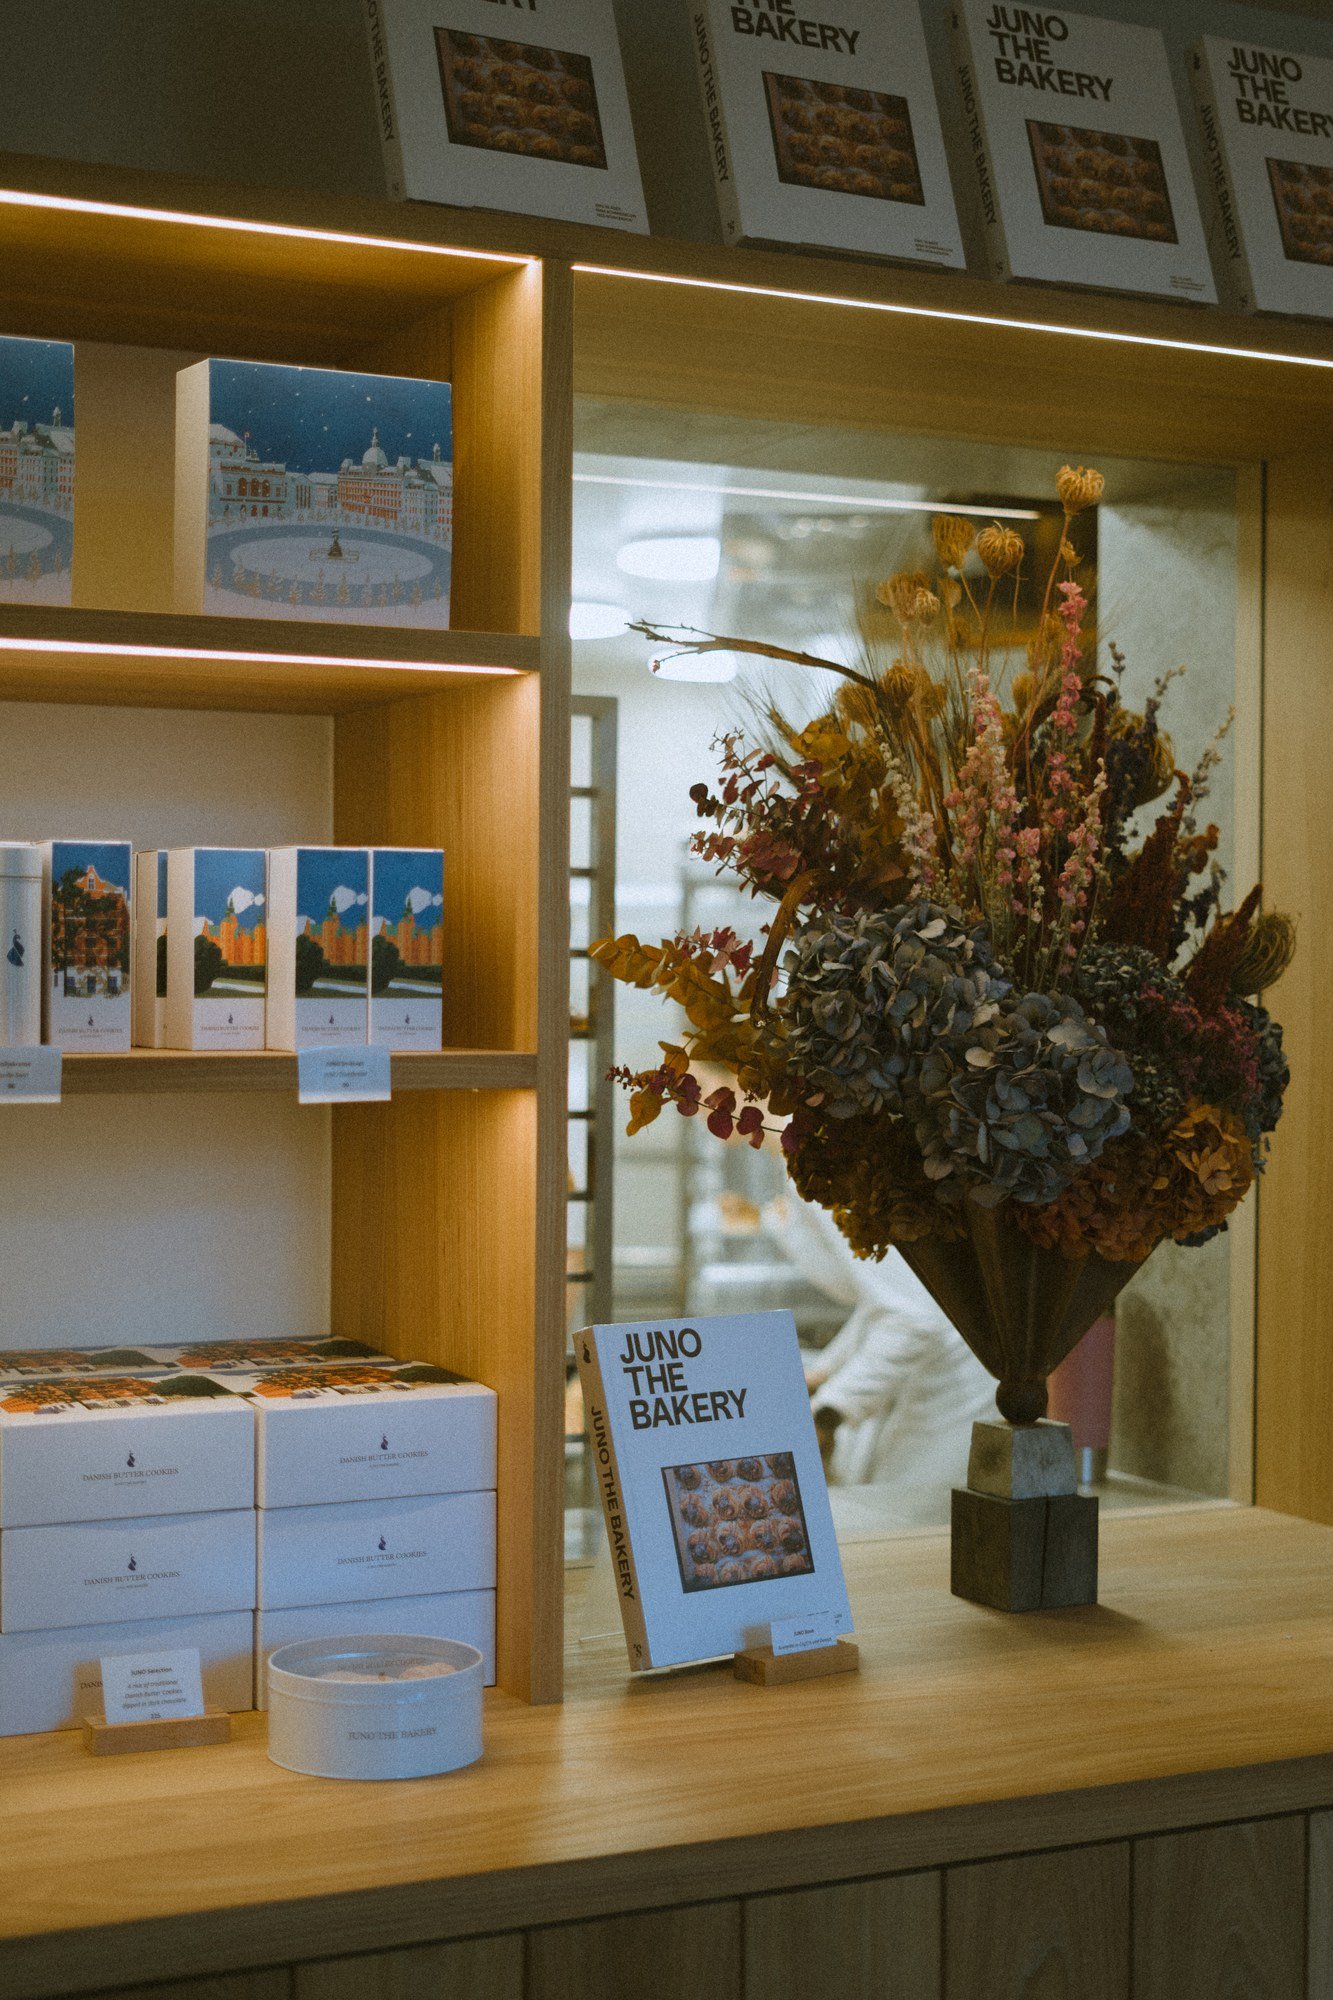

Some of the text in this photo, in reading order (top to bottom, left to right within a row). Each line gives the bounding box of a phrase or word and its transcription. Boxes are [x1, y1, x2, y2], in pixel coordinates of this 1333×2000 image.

[731, 6, 860, 55] BAKERY
[986, 5, 1069, 41] JUNO
[989, 30, 1053, 65] THE
[1227, 47, 1302, 82] JUNO
[994, 57, 1114, 102] BAKERY
[1230, 71, 1289, 105] THE
[376, 63, 395, 141] BAKERY
[694, 13, 729, 183] JUNO THE BAKERY
[958, 65, 996, 225] JUNO THE BAKERY
[1210, 150, 1226, 189] THE
[1218, 189, 1241, 259] BAKERY
[620, 1328, 702, 1364] JUNO
[623, 1362, 688, 1396] THE
[629, 1388, 747, 1430] BAKERY
[340, 1450, 428, 1464] DANISH BUTTER COOKIES
[82, 1468, 179, 1482] DANISH BUTTER COOKIES
[590, 1405, 635, 1600] JUNO THE BAKERY
[338, 1550, 427, 1564] DANISH BUTTER COOKIES
[84, 1571, 180, 1586] DANISH BUTTER COOKIES
[80, 1681, 103, 1690] DANIS
[348, 1727, 437, 1741] JUNO THE BAKERY
